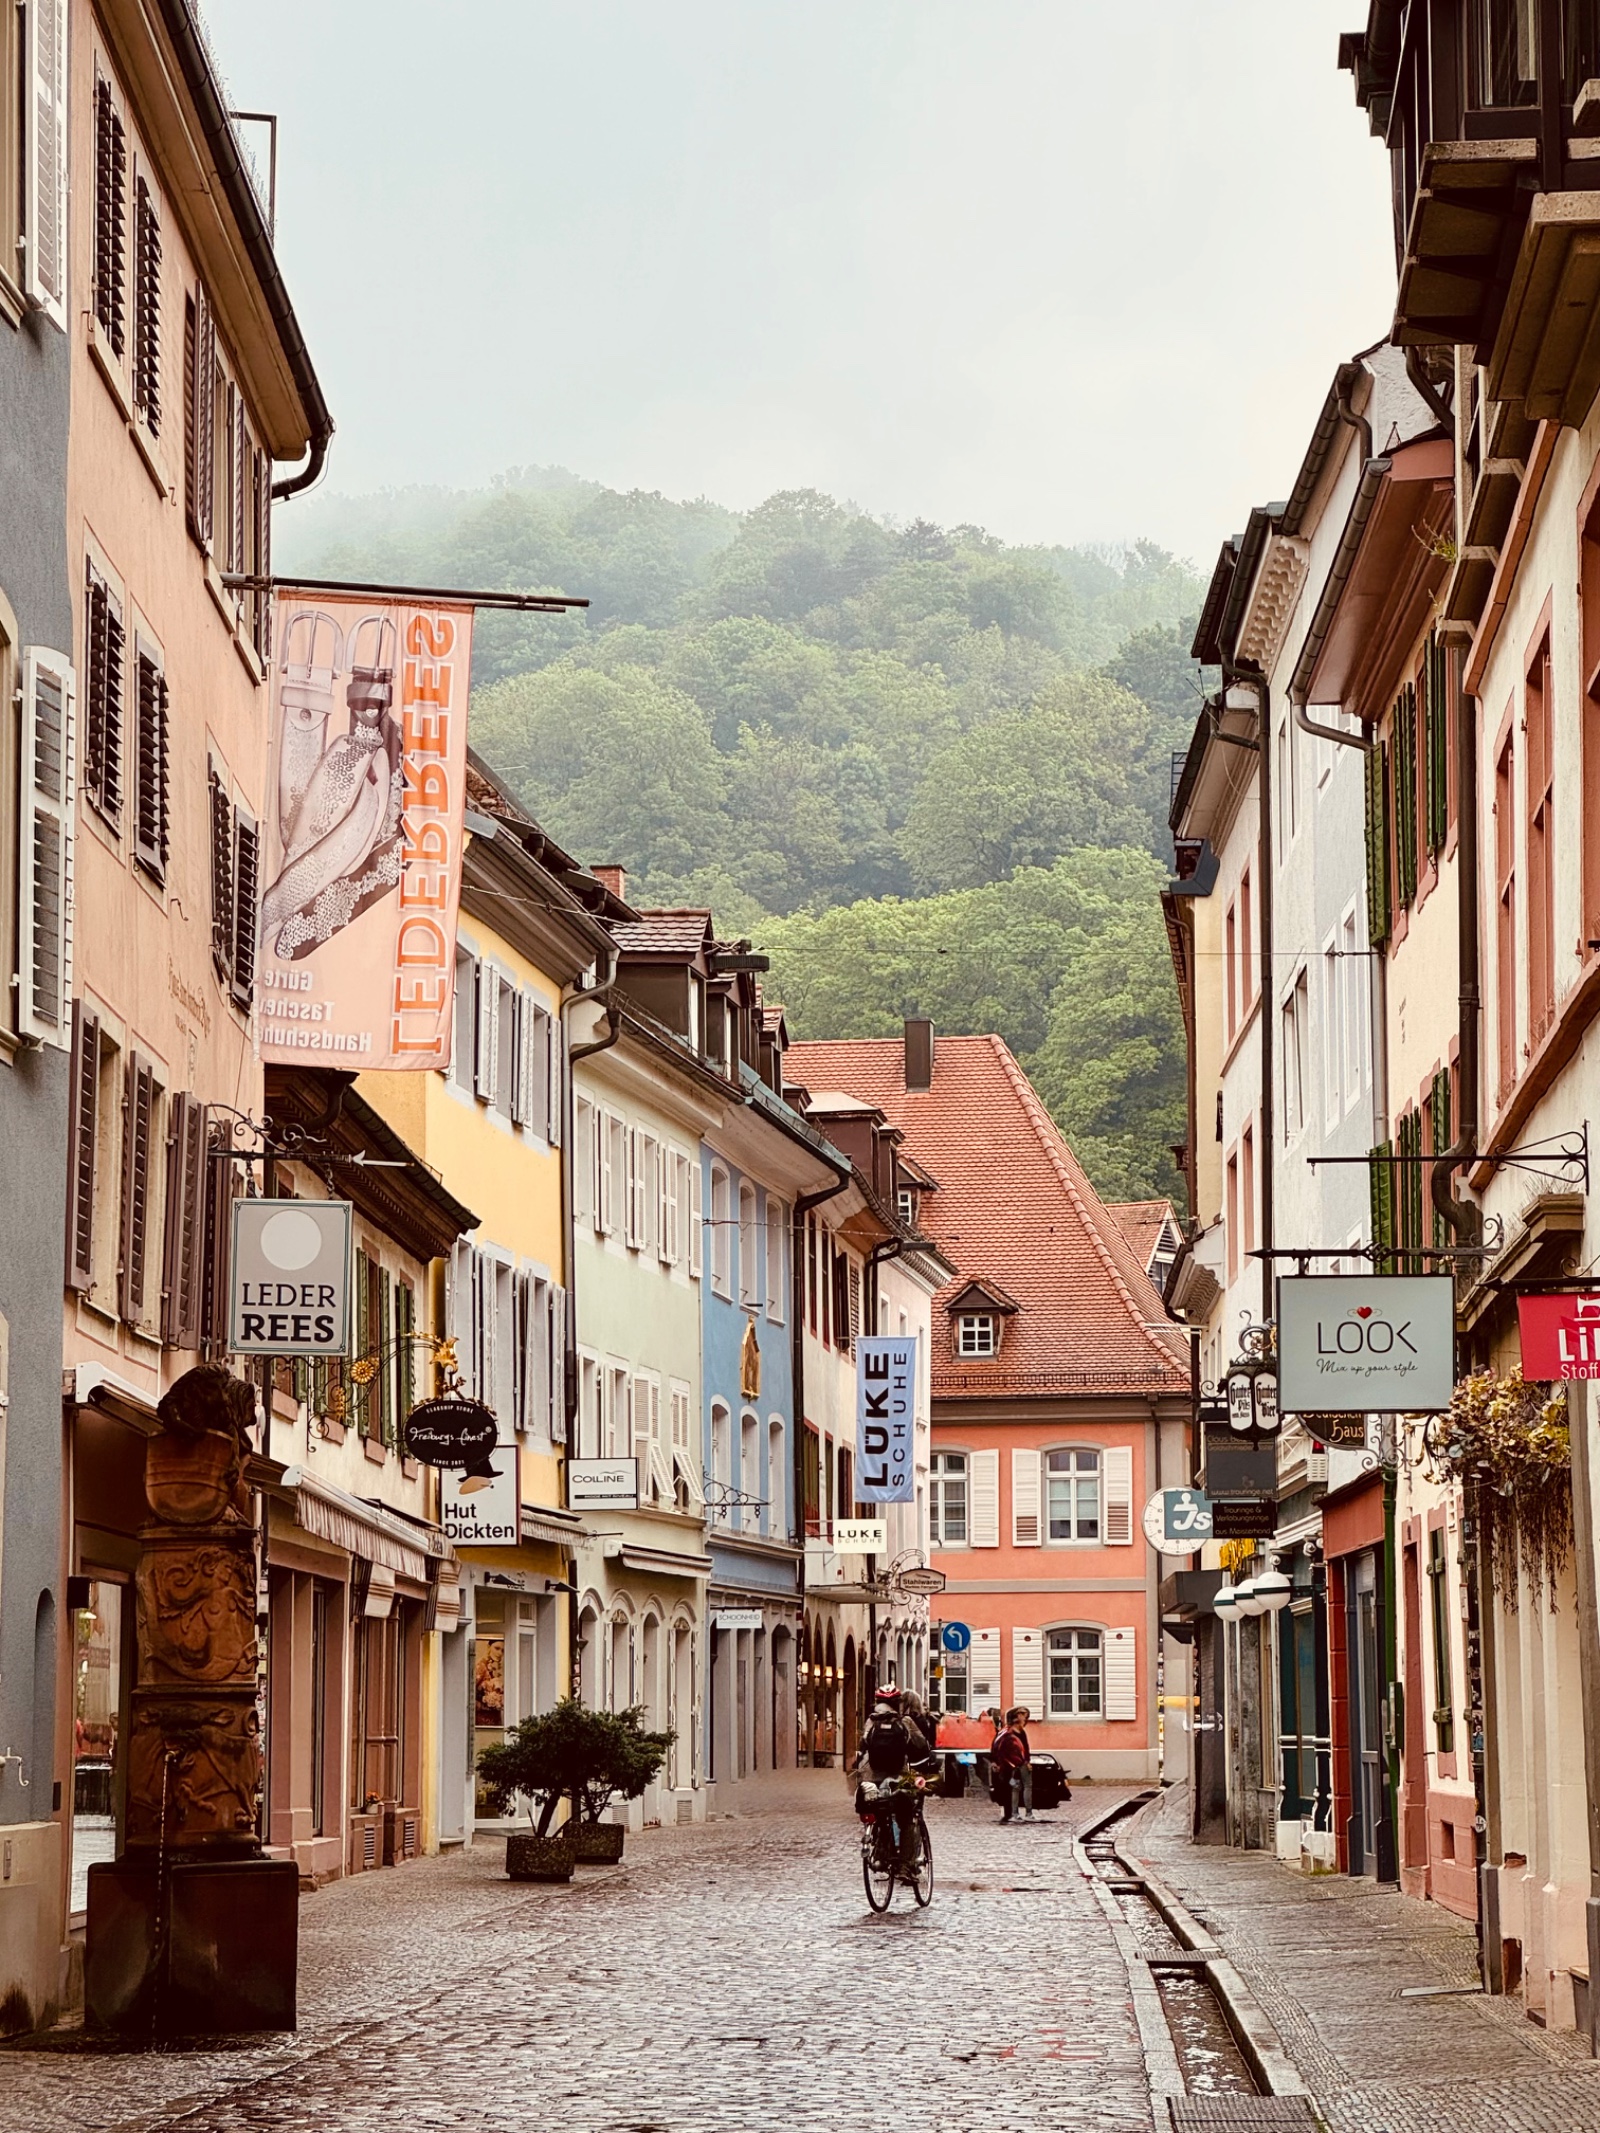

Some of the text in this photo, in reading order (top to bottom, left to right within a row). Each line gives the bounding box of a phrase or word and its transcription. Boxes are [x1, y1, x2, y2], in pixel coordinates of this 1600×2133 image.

[242, 1283, 336, 1308] LEDER
[241, 1313, 335, 1343] REES
[1317, 1321, 1418, 1354] LOOK
[1316, 1358, 1418, 1378] Mix up your style
[1560, 1362, 1599, 1380] Stoff
[864, 1353, 889, 1487] LÜKE
[892, 1353, 907, 1487] SCHUHE
[1329, 1419, 1364, 1443] Haus
[409, 1427, 454, 1445] Freiburgs
[1211, 1488, 1274, 1497] www.trauringe.net
[445, 1503, 477, 1519] Hut
[445, 1522, 514, 1539] Dickten
